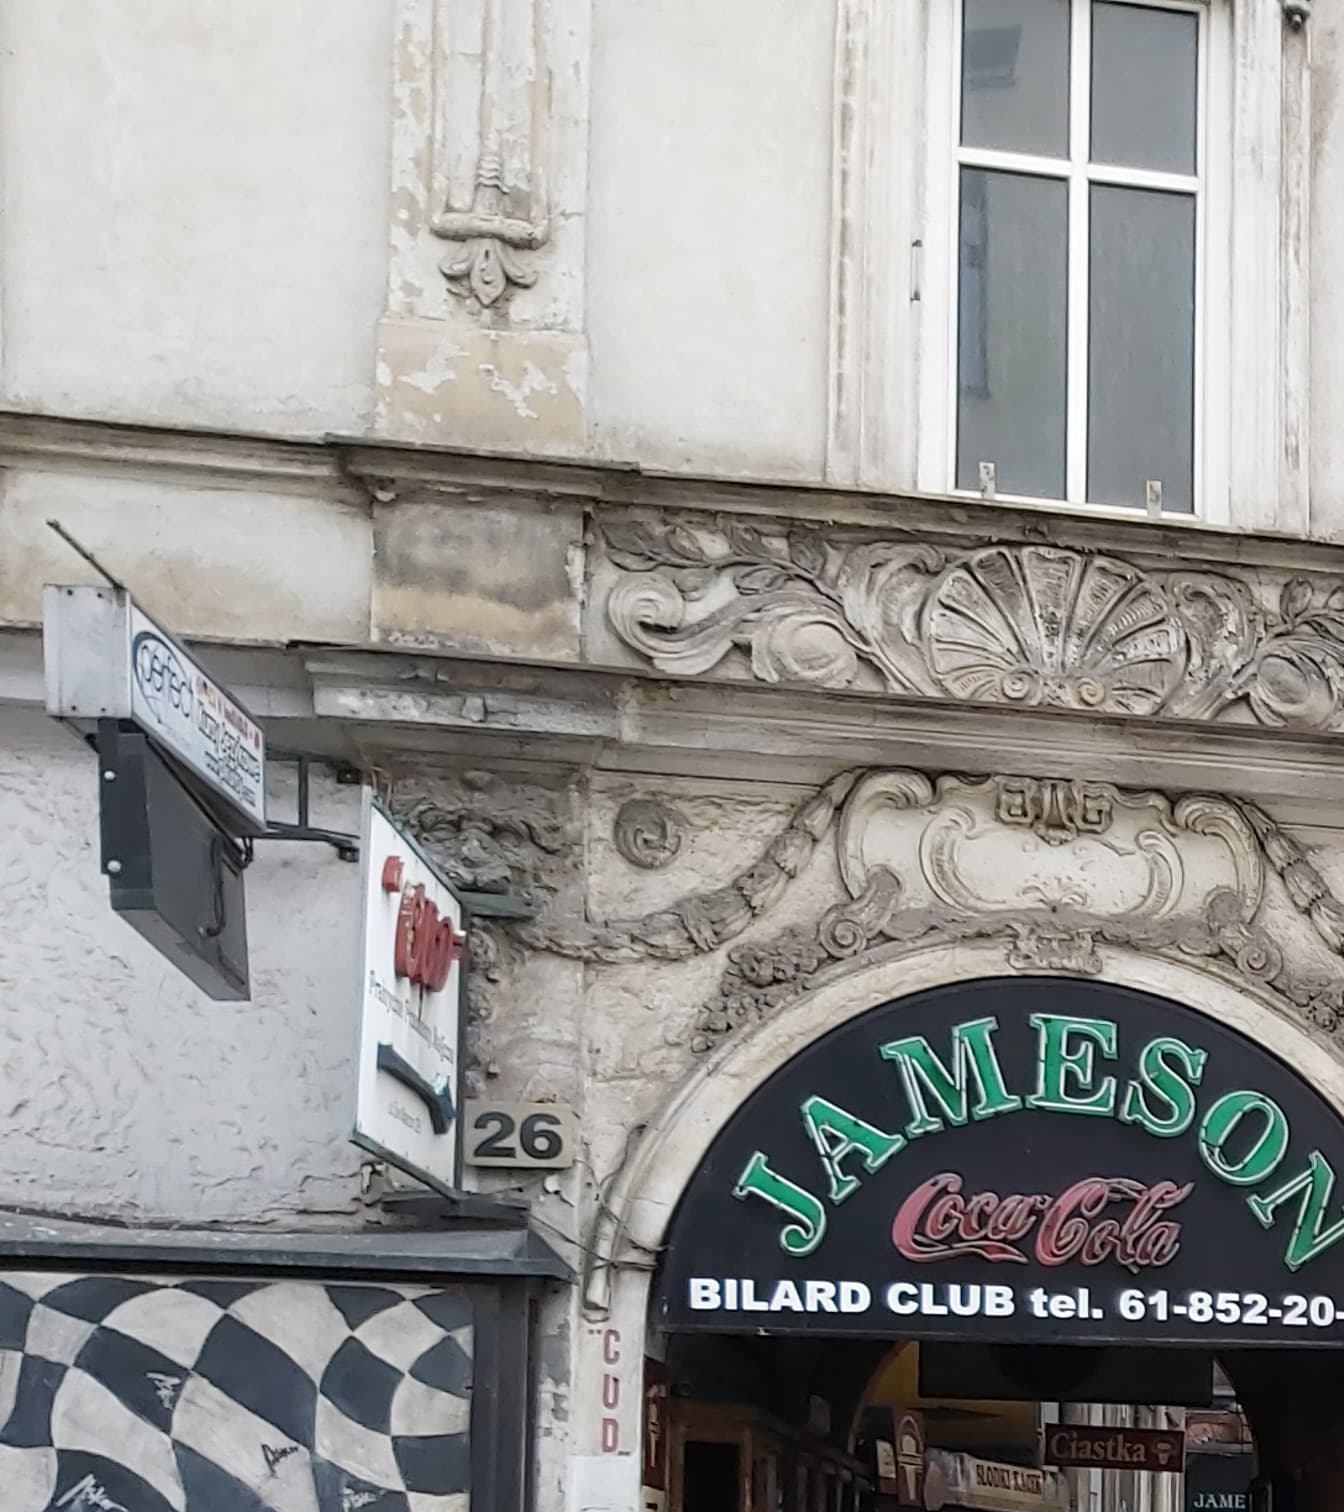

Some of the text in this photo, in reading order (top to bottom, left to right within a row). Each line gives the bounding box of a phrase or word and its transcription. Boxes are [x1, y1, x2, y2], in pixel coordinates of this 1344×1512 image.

[473, 1111, 563, 1160] 26
[689, 1277, 872, 1314] BILARD
[887, 1281, 1015, 1318] CLUB
[1031, 1285, 1103, 1320] tel.
[602, 1329, 621, 1453] CUD
[1050, 1431, 1146, 1463] Ciastka
